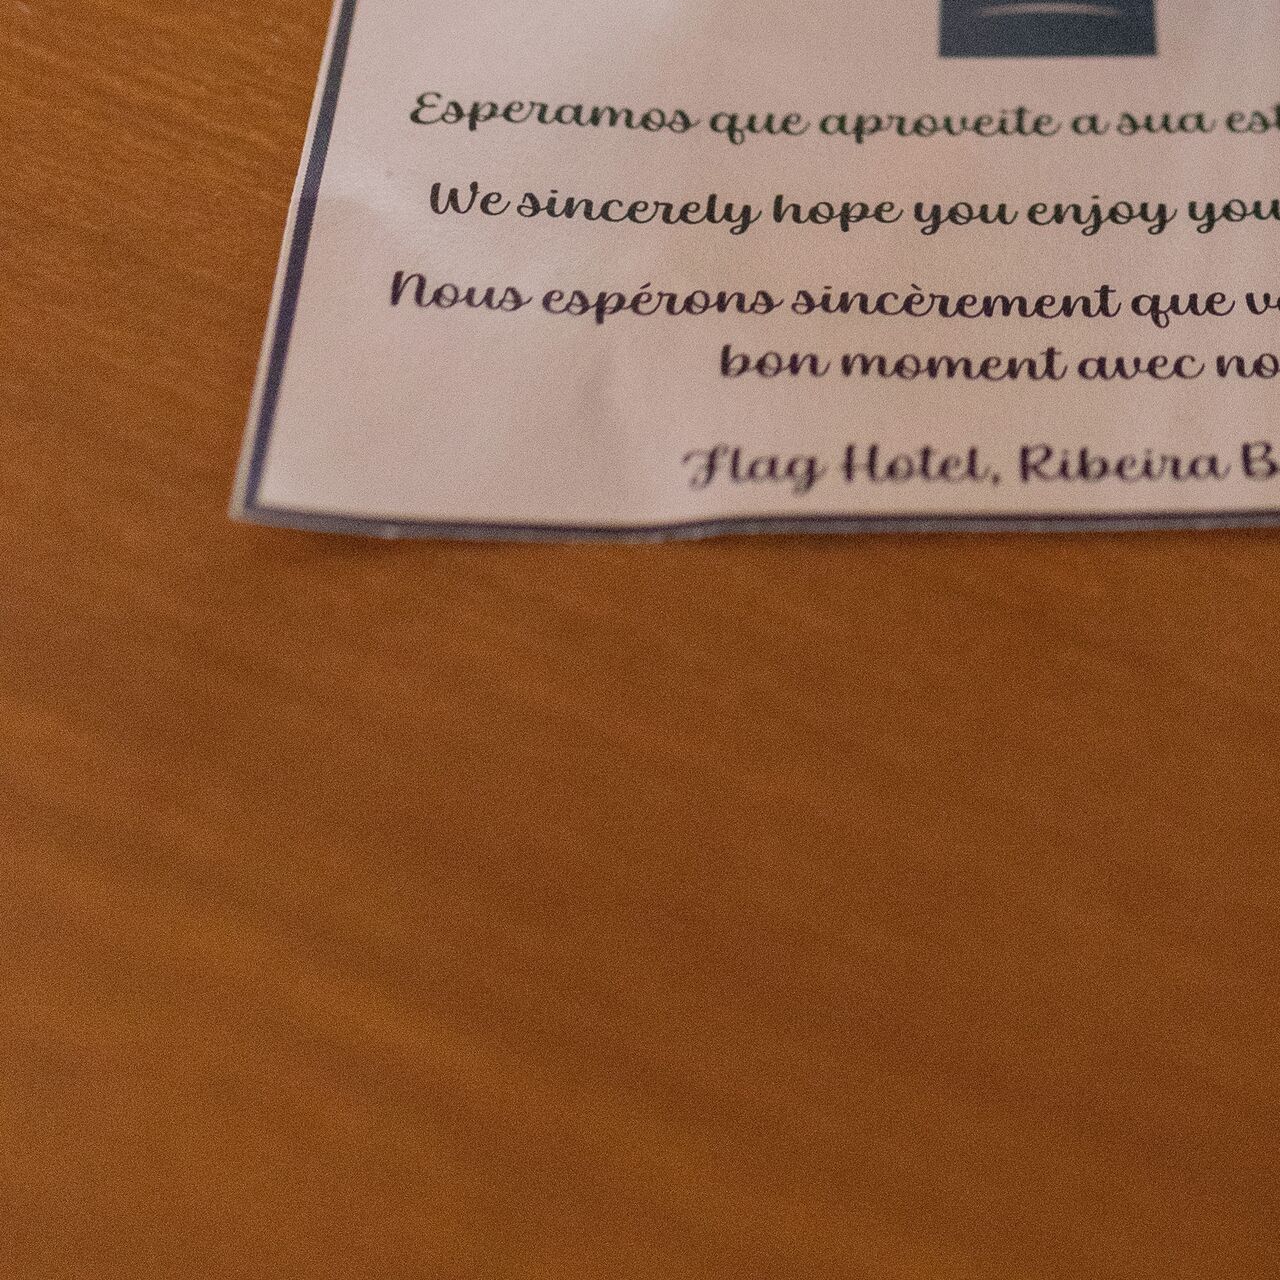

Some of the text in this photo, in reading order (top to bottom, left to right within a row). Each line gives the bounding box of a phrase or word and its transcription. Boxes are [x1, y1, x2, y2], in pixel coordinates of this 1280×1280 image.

[408, 91, 700, 134] Esperamos
[708, 111, 810, 146] que
[818, 106, 1060, 145] aproveite
[1070, 114, 1109, 136] a
[1116, 112, 1215, 136] sua
[429, 180, 511, 217] We
[516, 189, 762, 236] sincerely
[772, 194, 904, 233] hope
[913, 201, 1019, 236] you
[1026, 195, 1177, 237] enjoy
[389, 269, 532, 312] Nous
[541, 282, 784, 326] espérons
[790, 283, 1122, 319] sincèrement
[1130, 292, 1235, 329] que
[719, 344, 830, 378] bon
[840, 346, 1068, 382] moment
[1076, 355, 1205, 381] avec
[681, 442, 824, 493] Flag
[841, 442, 1001, 487] Hotel,
[1018, 442, 1226, 482] Ribeira
